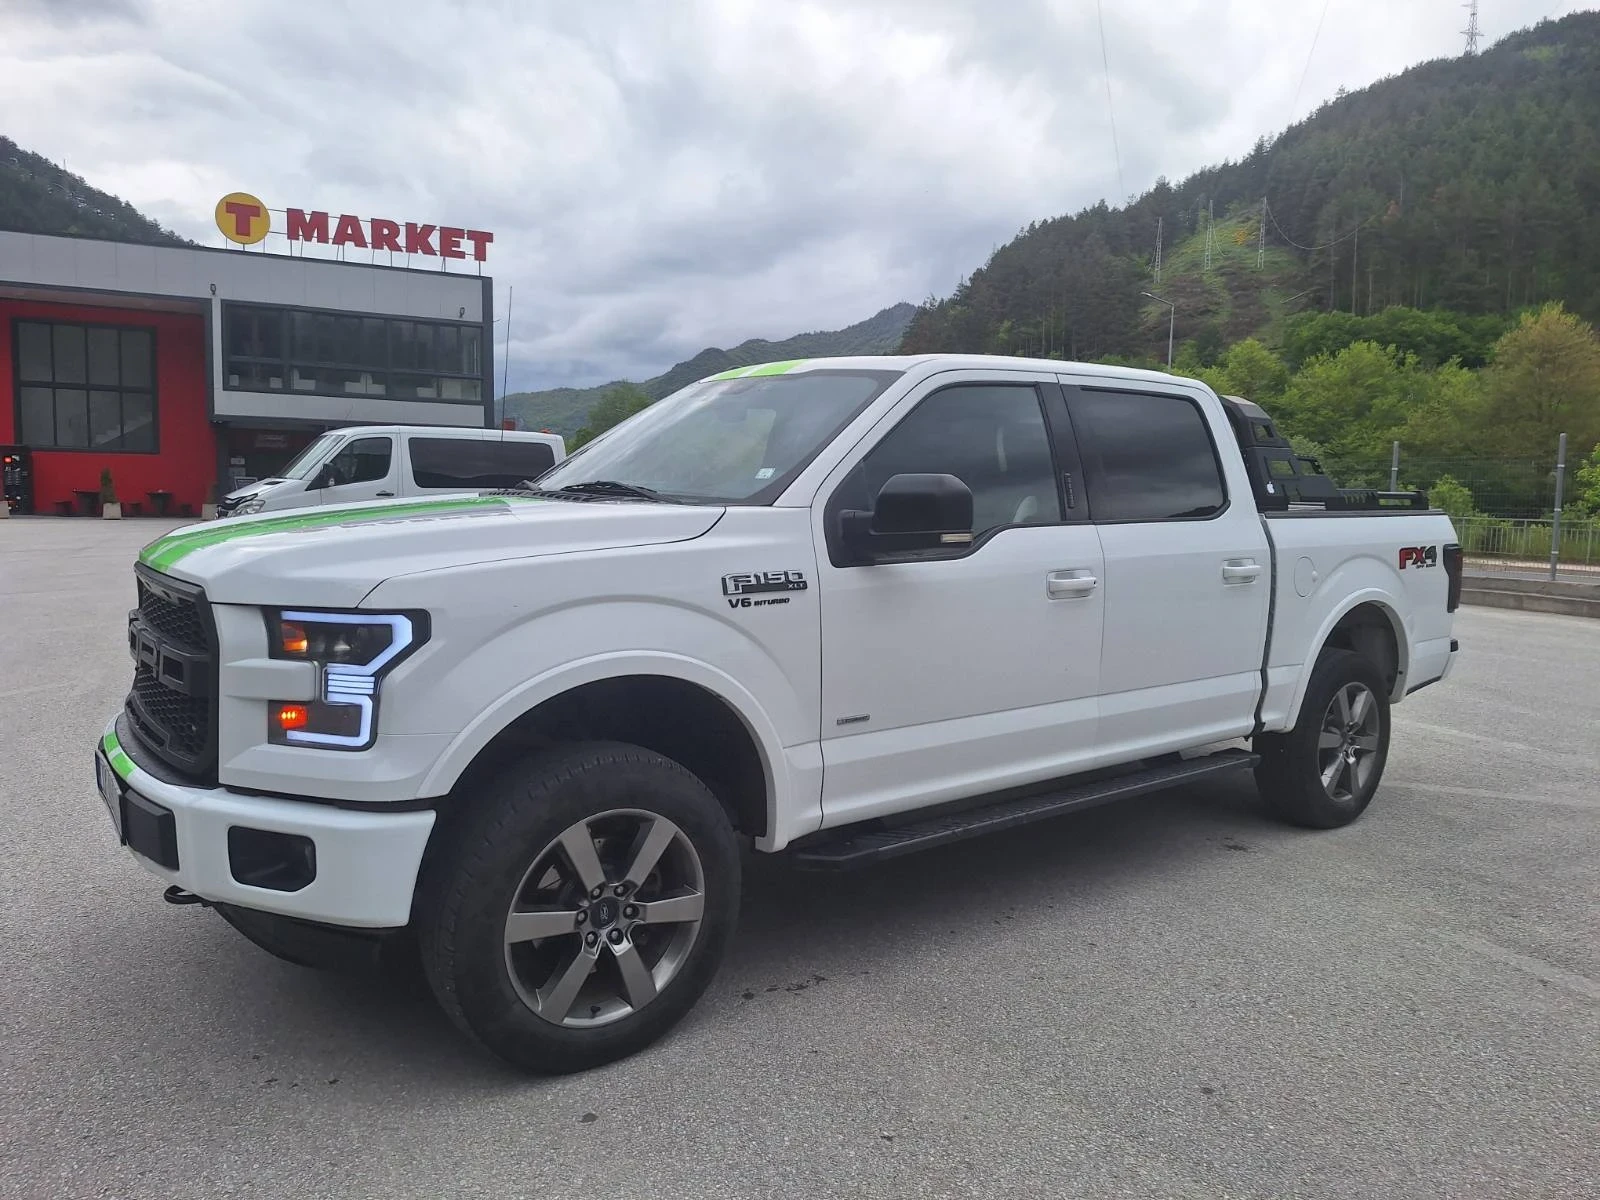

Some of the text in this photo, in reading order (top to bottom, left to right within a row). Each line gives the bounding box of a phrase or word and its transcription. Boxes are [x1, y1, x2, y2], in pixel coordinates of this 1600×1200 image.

[226, 201, 494, 262] T MARKET
[1399, 545, 1438, 570] FX4
[728, 598, 790, 608] V6 BITURBO
